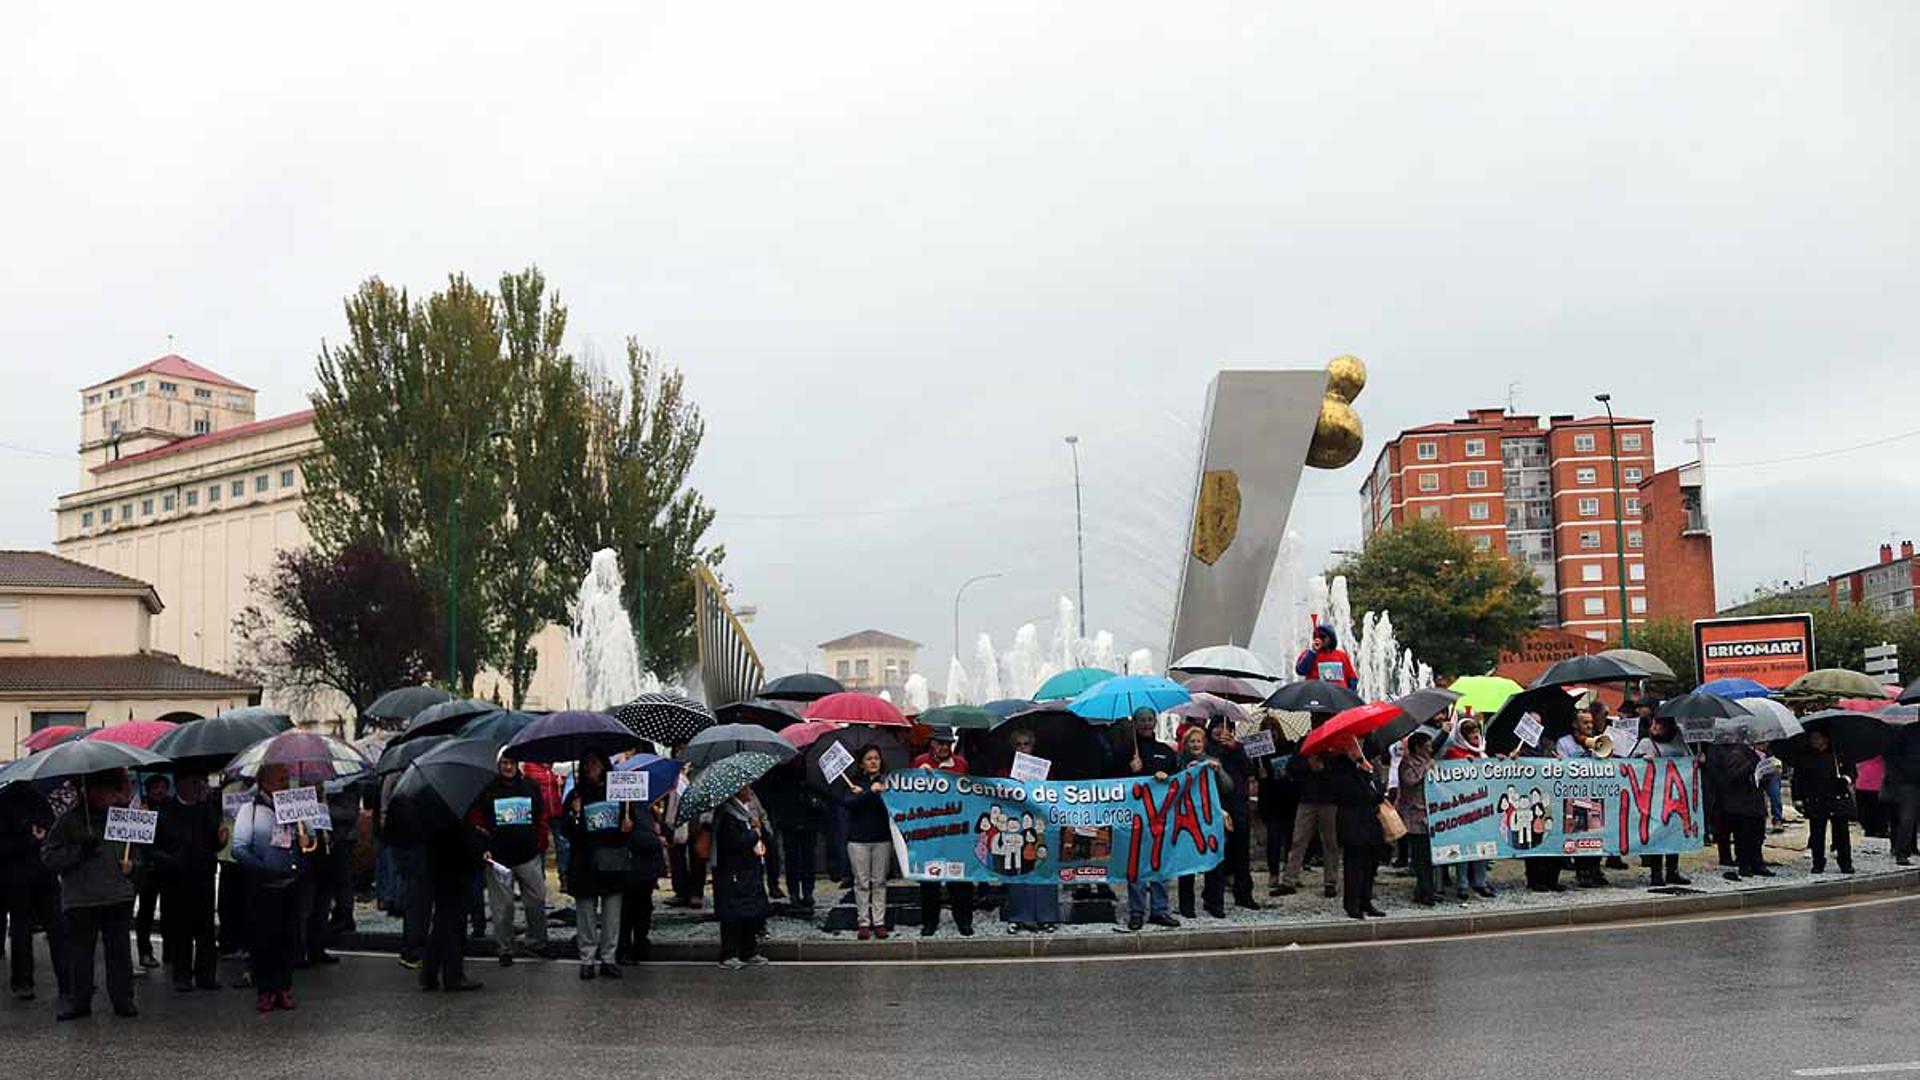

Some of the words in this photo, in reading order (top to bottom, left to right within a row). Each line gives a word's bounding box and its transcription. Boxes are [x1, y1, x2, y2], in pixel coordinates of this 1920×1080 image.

[1708, 641, 1801, 658] BRICOMART
[1428, 764, 1478, 784] Nuevo
[1482, 762, 1537, 780] Centro
[1541, 761, 1564, 779] de
[1568, 760, 1615, 780] Salud
[884, 773, 951, 793] Nuevo
[957, 776, 1027, 802] Centro
[1032, 784, 1059, 803] de
[1063, 783, 1125, 805] Salud
[1591, 781, 1620, 797] Lorca
[1095, 807, 1132, 825] Lorca
[1619, 757, 1699, 856] ¡YA!
[1126, 767, 1219, 884] ¡YA!
